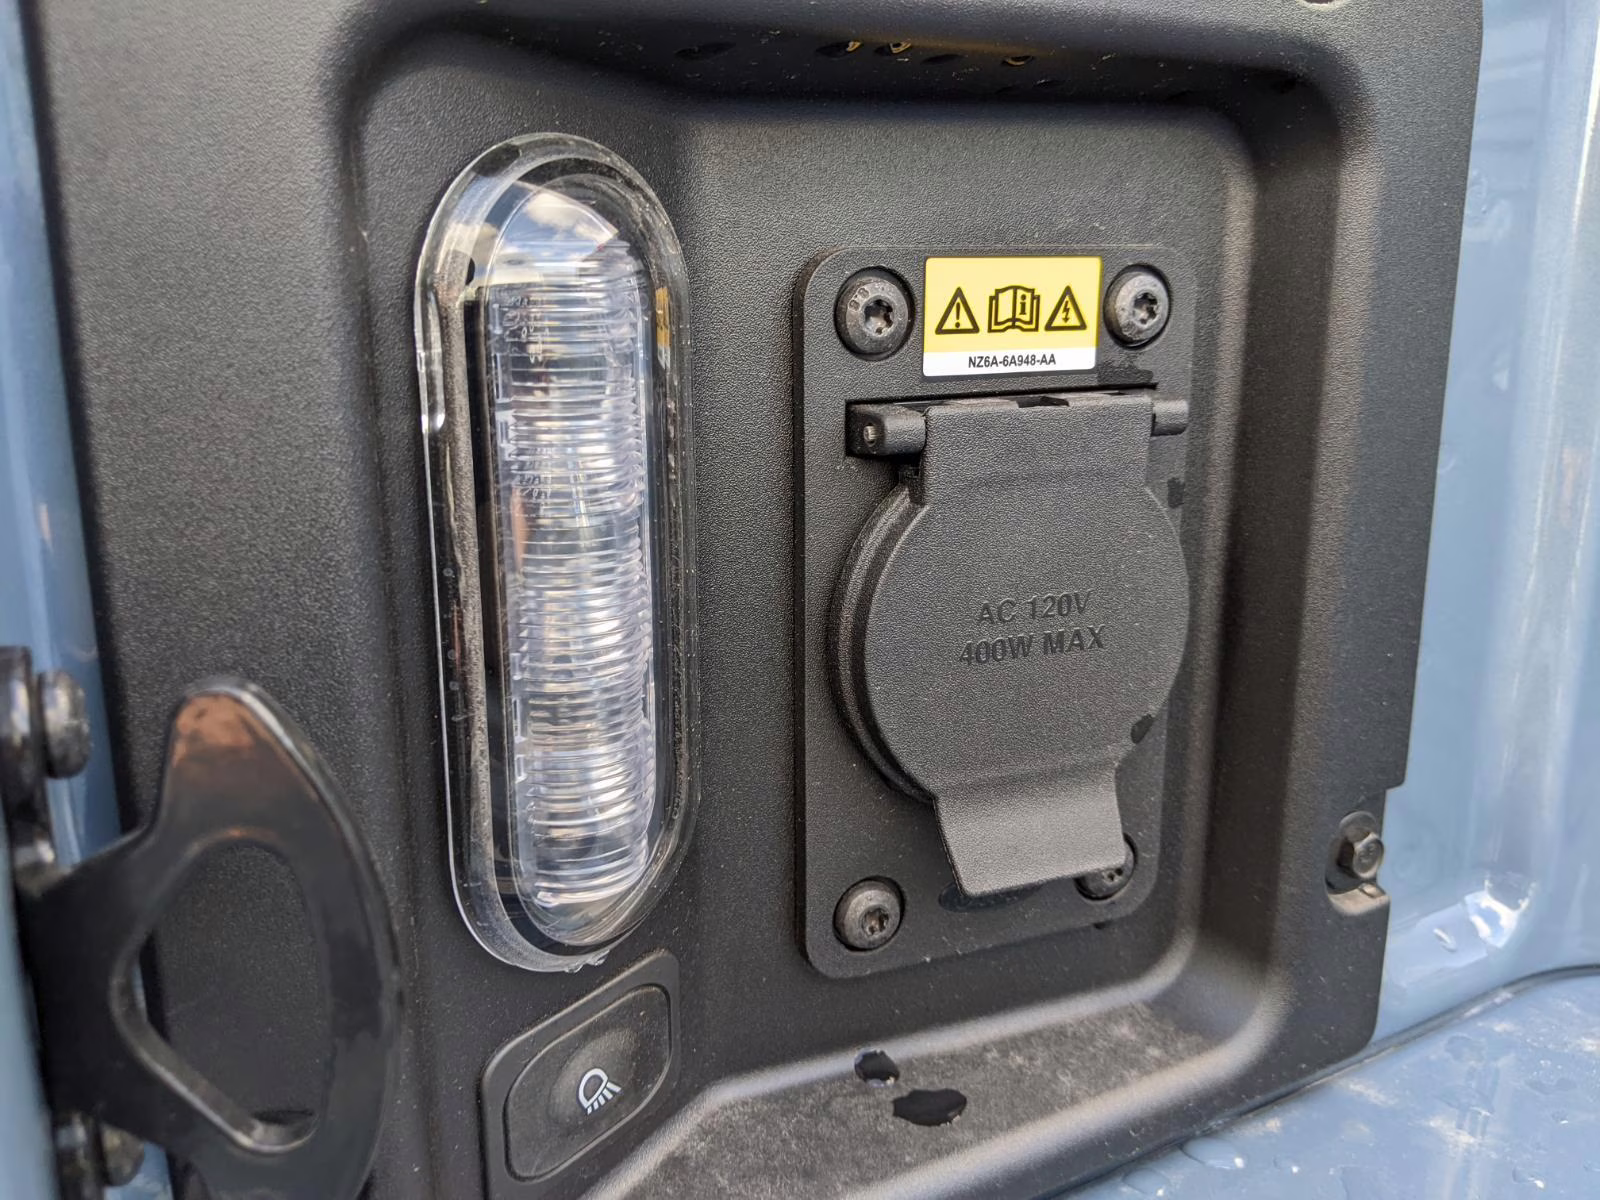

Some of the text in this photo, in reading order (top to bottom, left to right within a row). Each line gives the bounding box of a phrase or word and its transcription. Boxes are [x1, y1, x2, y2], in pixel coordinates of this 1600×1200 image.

[968, 353, 1056, 368] NZ6A-6A948-AA
[979, 588, 1093, 624] AC 120V
[960, 624, 1105, 664] 400W MAX
